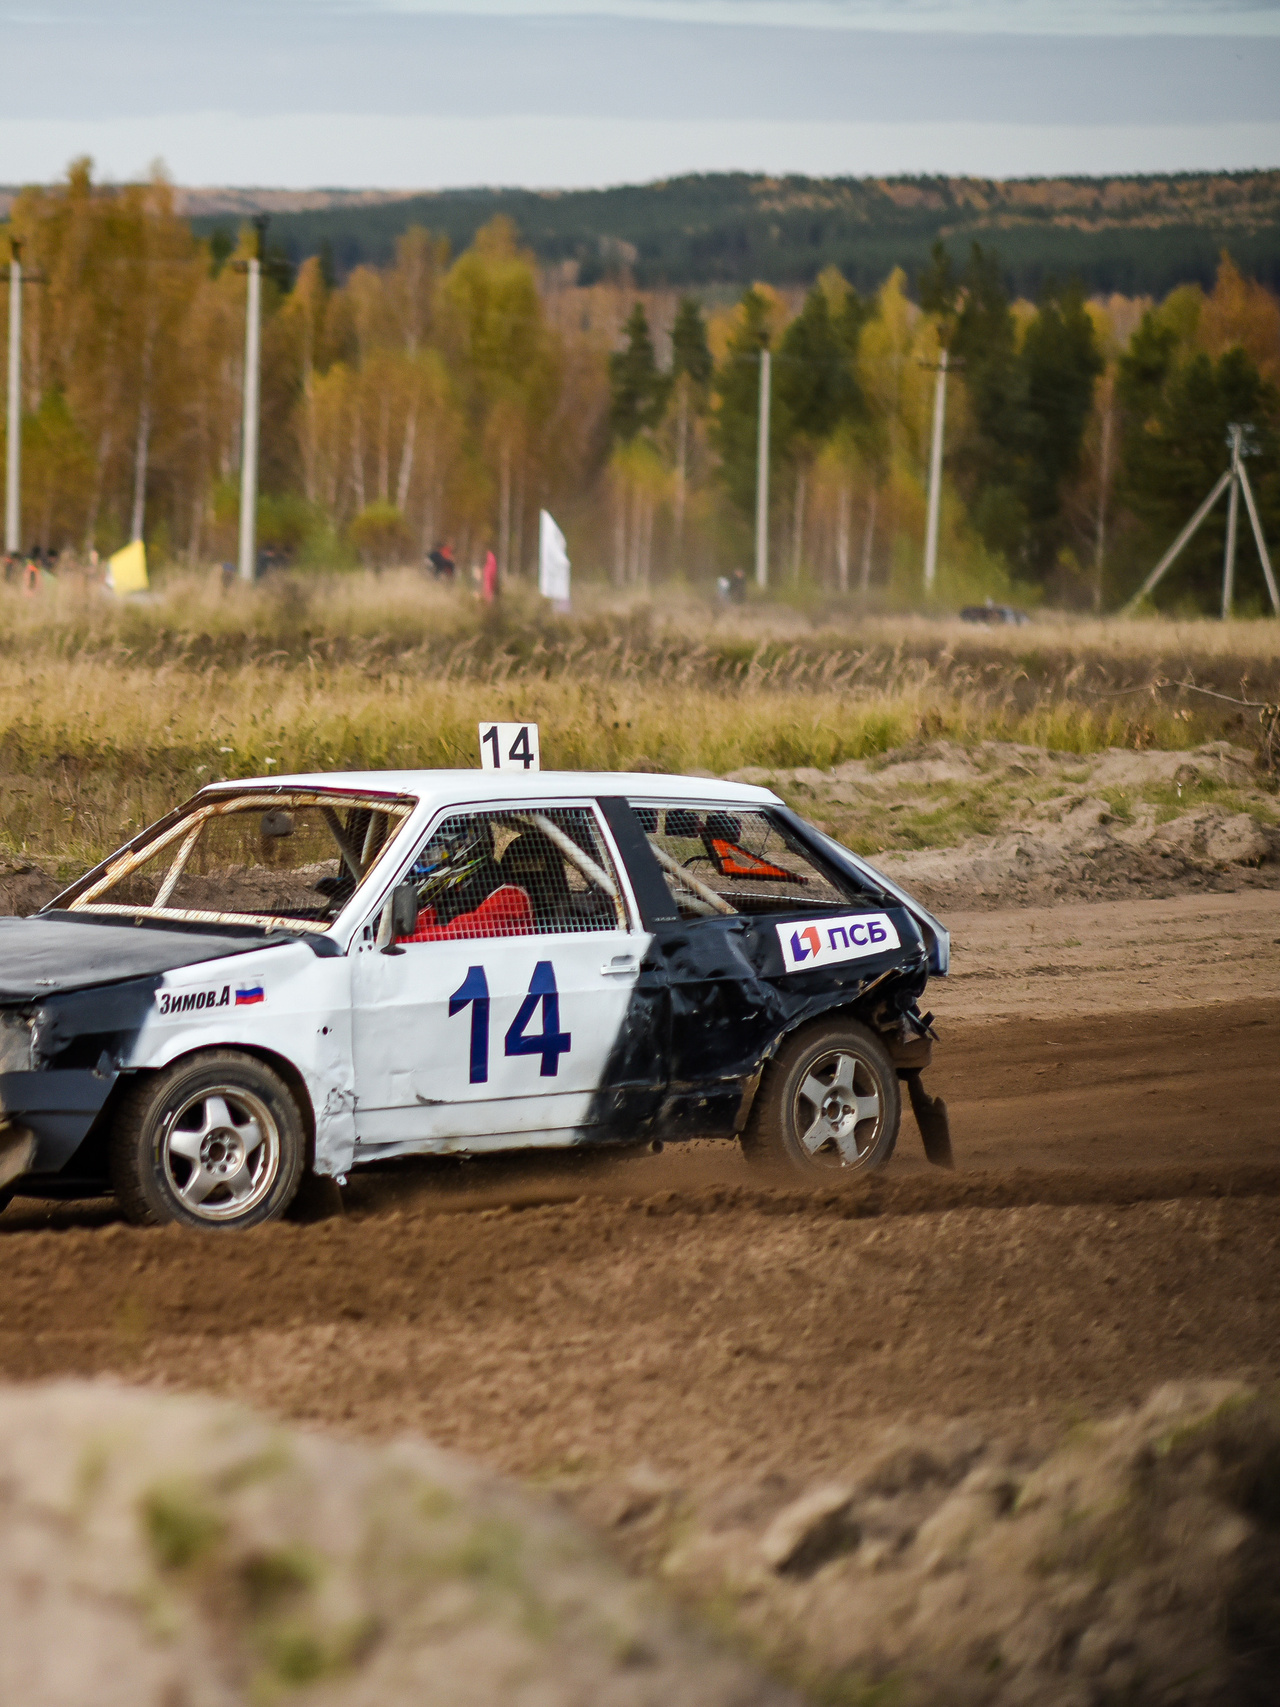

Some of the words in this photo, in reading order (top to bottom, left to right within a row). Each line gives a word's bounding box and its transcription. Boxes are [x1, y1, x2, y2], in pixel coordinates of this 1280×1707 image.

[483, 725, 534, 769] 14
[827, 921, 887, 950] ПСБ
[448, 960, 571, 1084] 14
